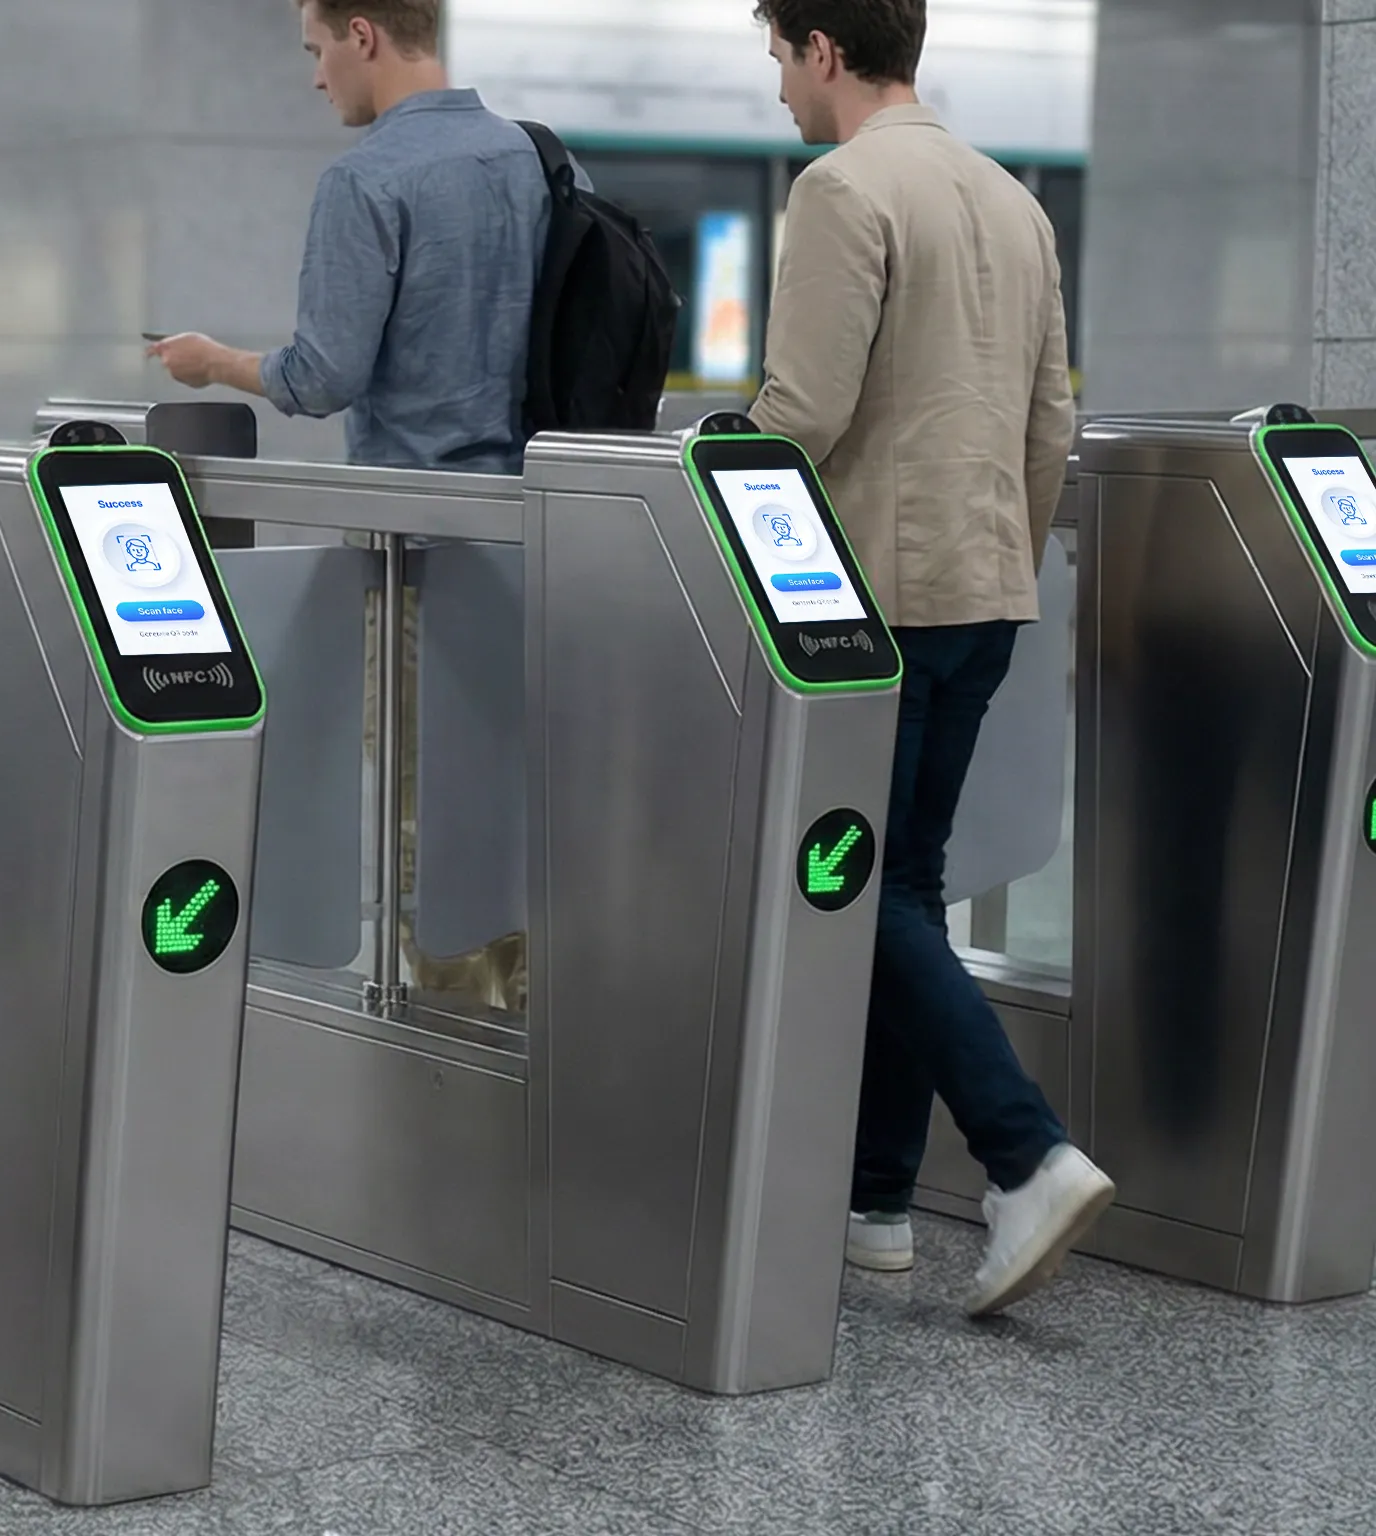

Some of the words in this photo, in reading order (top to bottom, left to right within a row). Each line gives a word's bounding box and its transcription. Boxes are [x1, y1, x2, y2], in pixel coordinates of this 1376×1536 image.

[1311, 468, 1345, 476] Success
[743, 483, 781, 491] Success
[97, 500, 143, 509] Success
[807, 578, 825, 586] face
[137, 607, 162, 616] Scan
[163, 607, 183, 615] face
